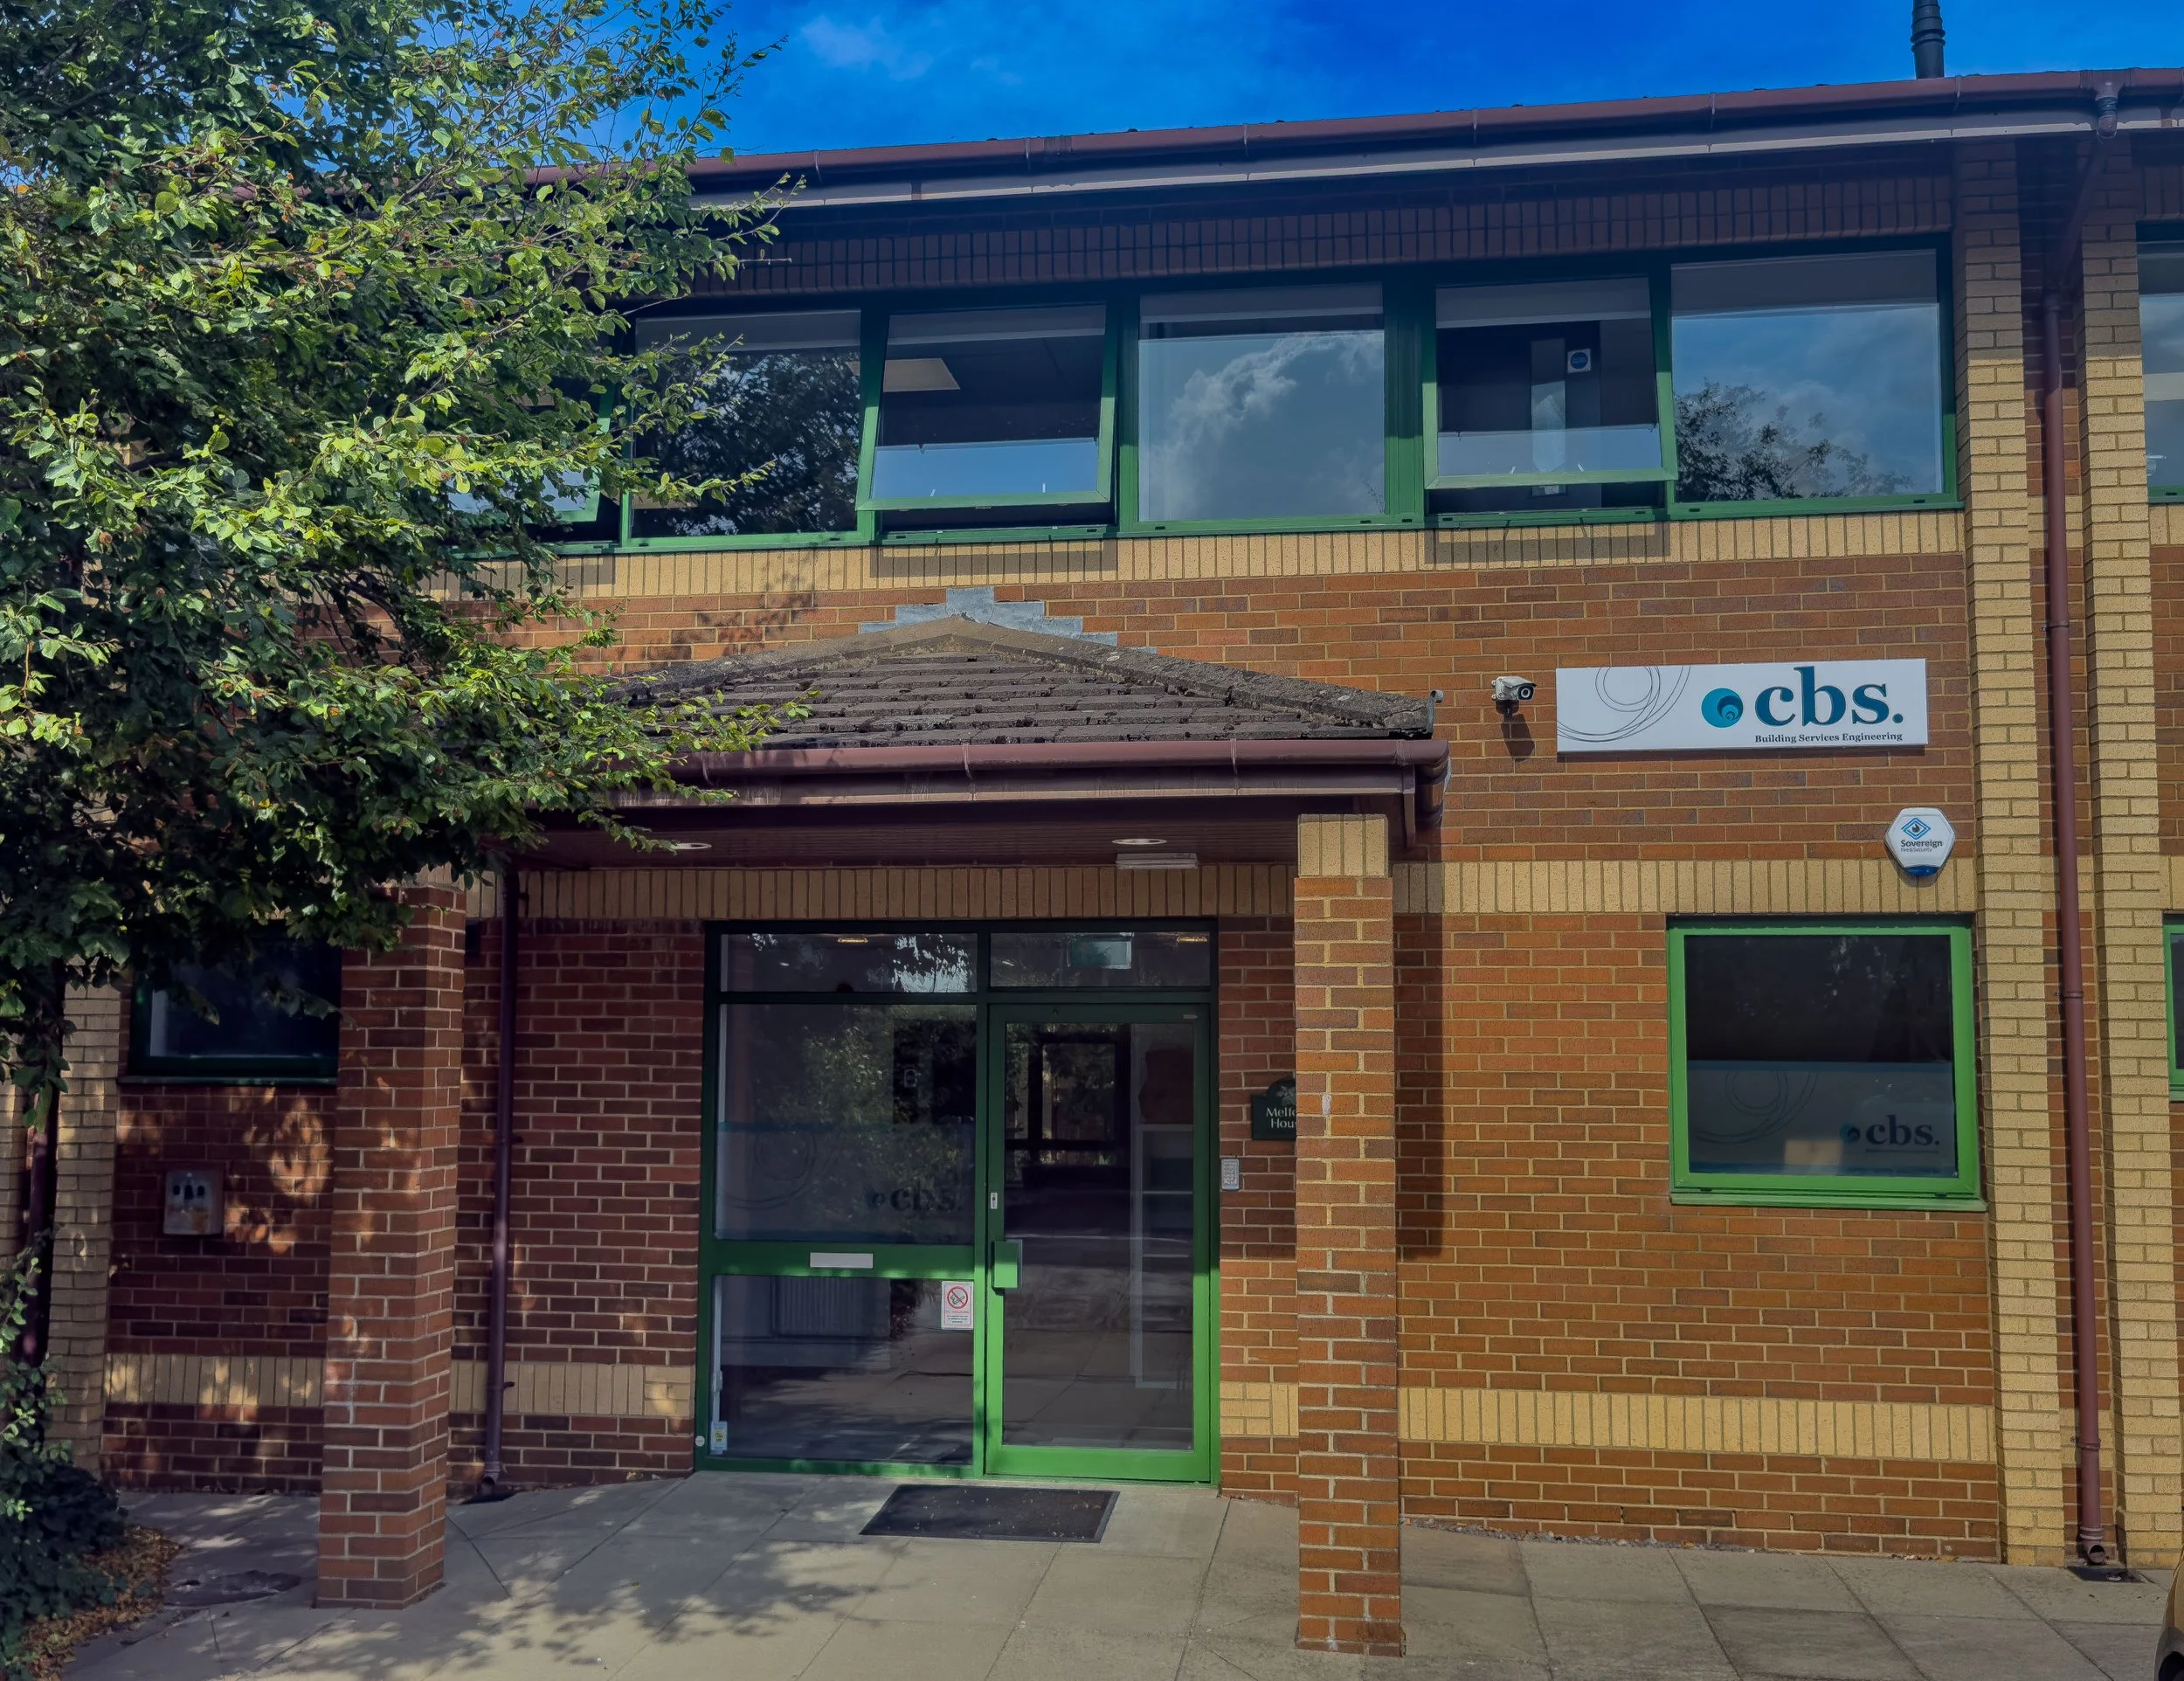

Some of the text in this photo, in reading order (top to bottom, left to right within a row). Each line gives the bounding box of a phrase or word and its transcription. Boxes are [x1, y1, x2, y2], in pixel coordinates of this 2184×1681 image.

[1754, 666, 1904, 727] cbs.
[1755, 732, 1903, 744] Building Services Engineering
[1900, 839, 1943, 848] Sovereign
[1271, 1118, 1296, 1128] Hou
[1866, 1114, 1939, 1145] cbs.
